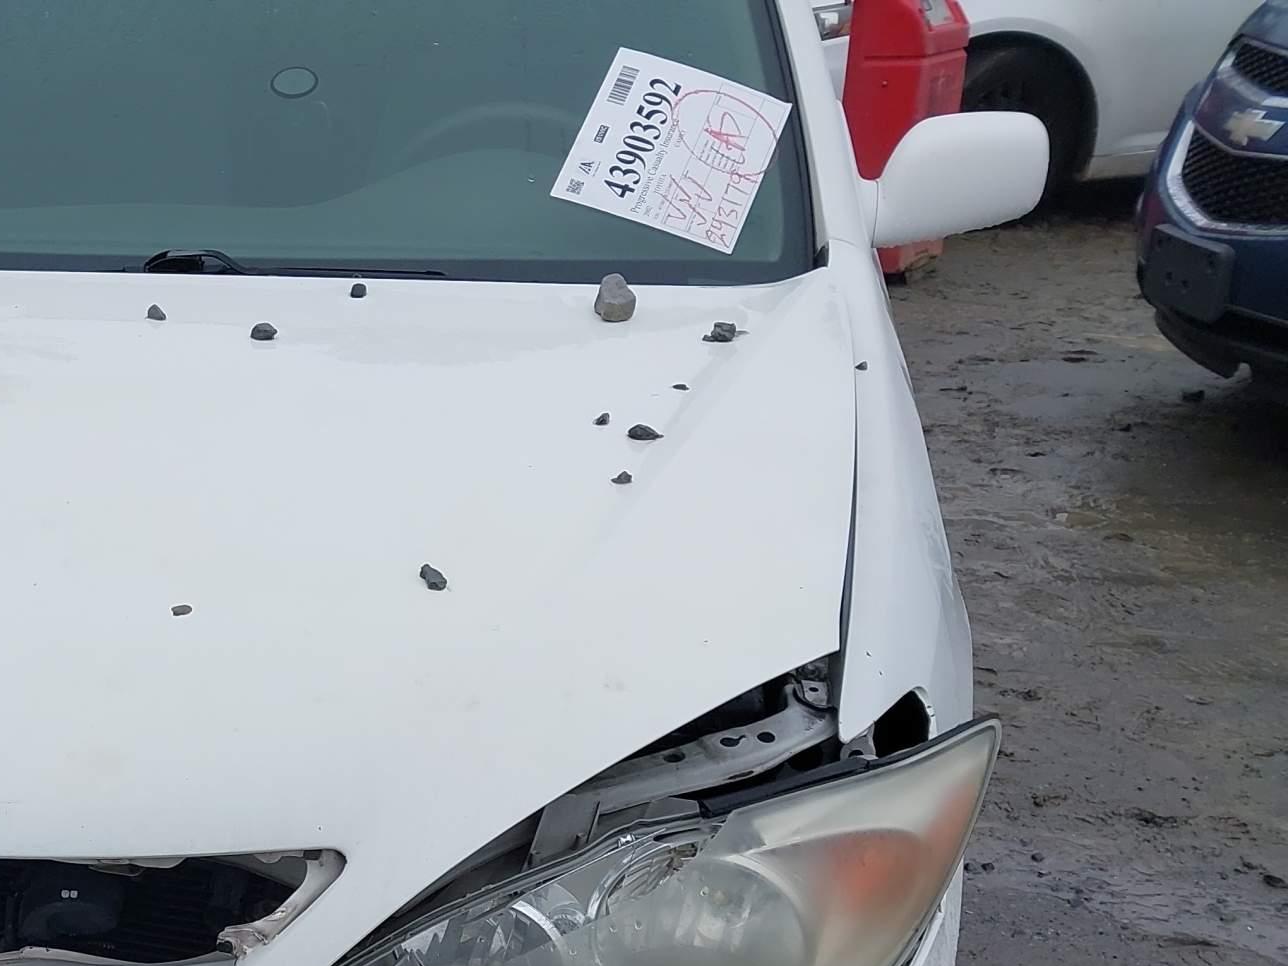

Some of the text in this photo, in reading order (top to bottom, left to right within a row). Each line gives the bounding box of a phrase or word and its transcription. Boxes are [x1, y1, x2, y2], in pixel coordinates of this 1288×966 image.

[603, 78, 682, 198] 43903592
[630, 174, 653, 213] Progressive
[647, 149, 667, 176] Casualty
